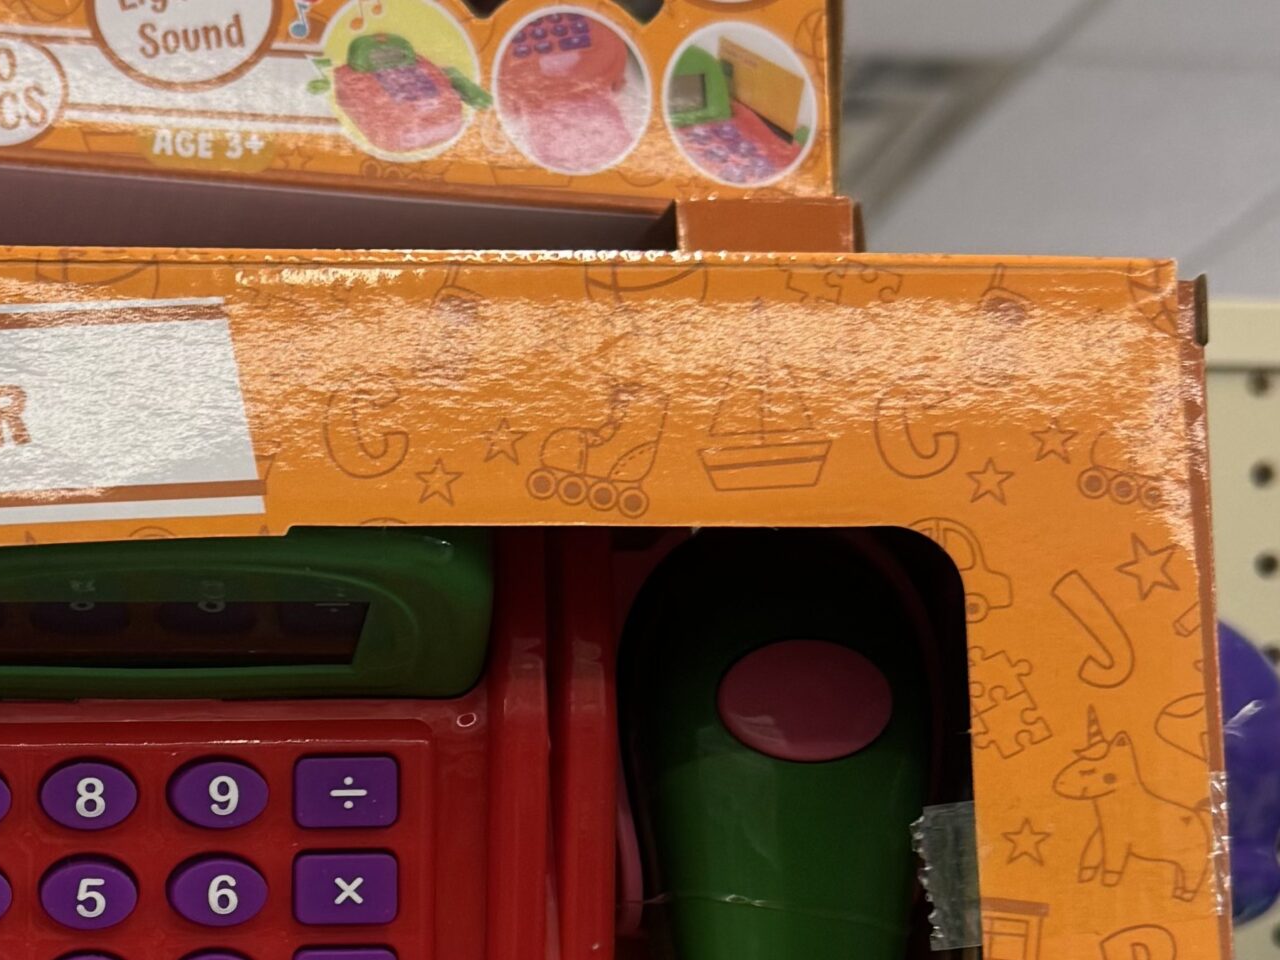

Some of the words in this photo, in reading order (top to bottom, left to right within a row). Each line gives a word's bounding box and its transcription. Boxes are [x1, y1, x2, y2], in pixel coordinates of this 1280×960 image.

[138, 13, 246, 60] Sound
[151, 128, 214, 158] AGE
[224, 130, 266, 159] 3+
[75, 777, 106, 818] 8
[208, 775, 239, 816] 9
[75, 878, 106, 918] 5
[207, 874, 239, 915] 6
